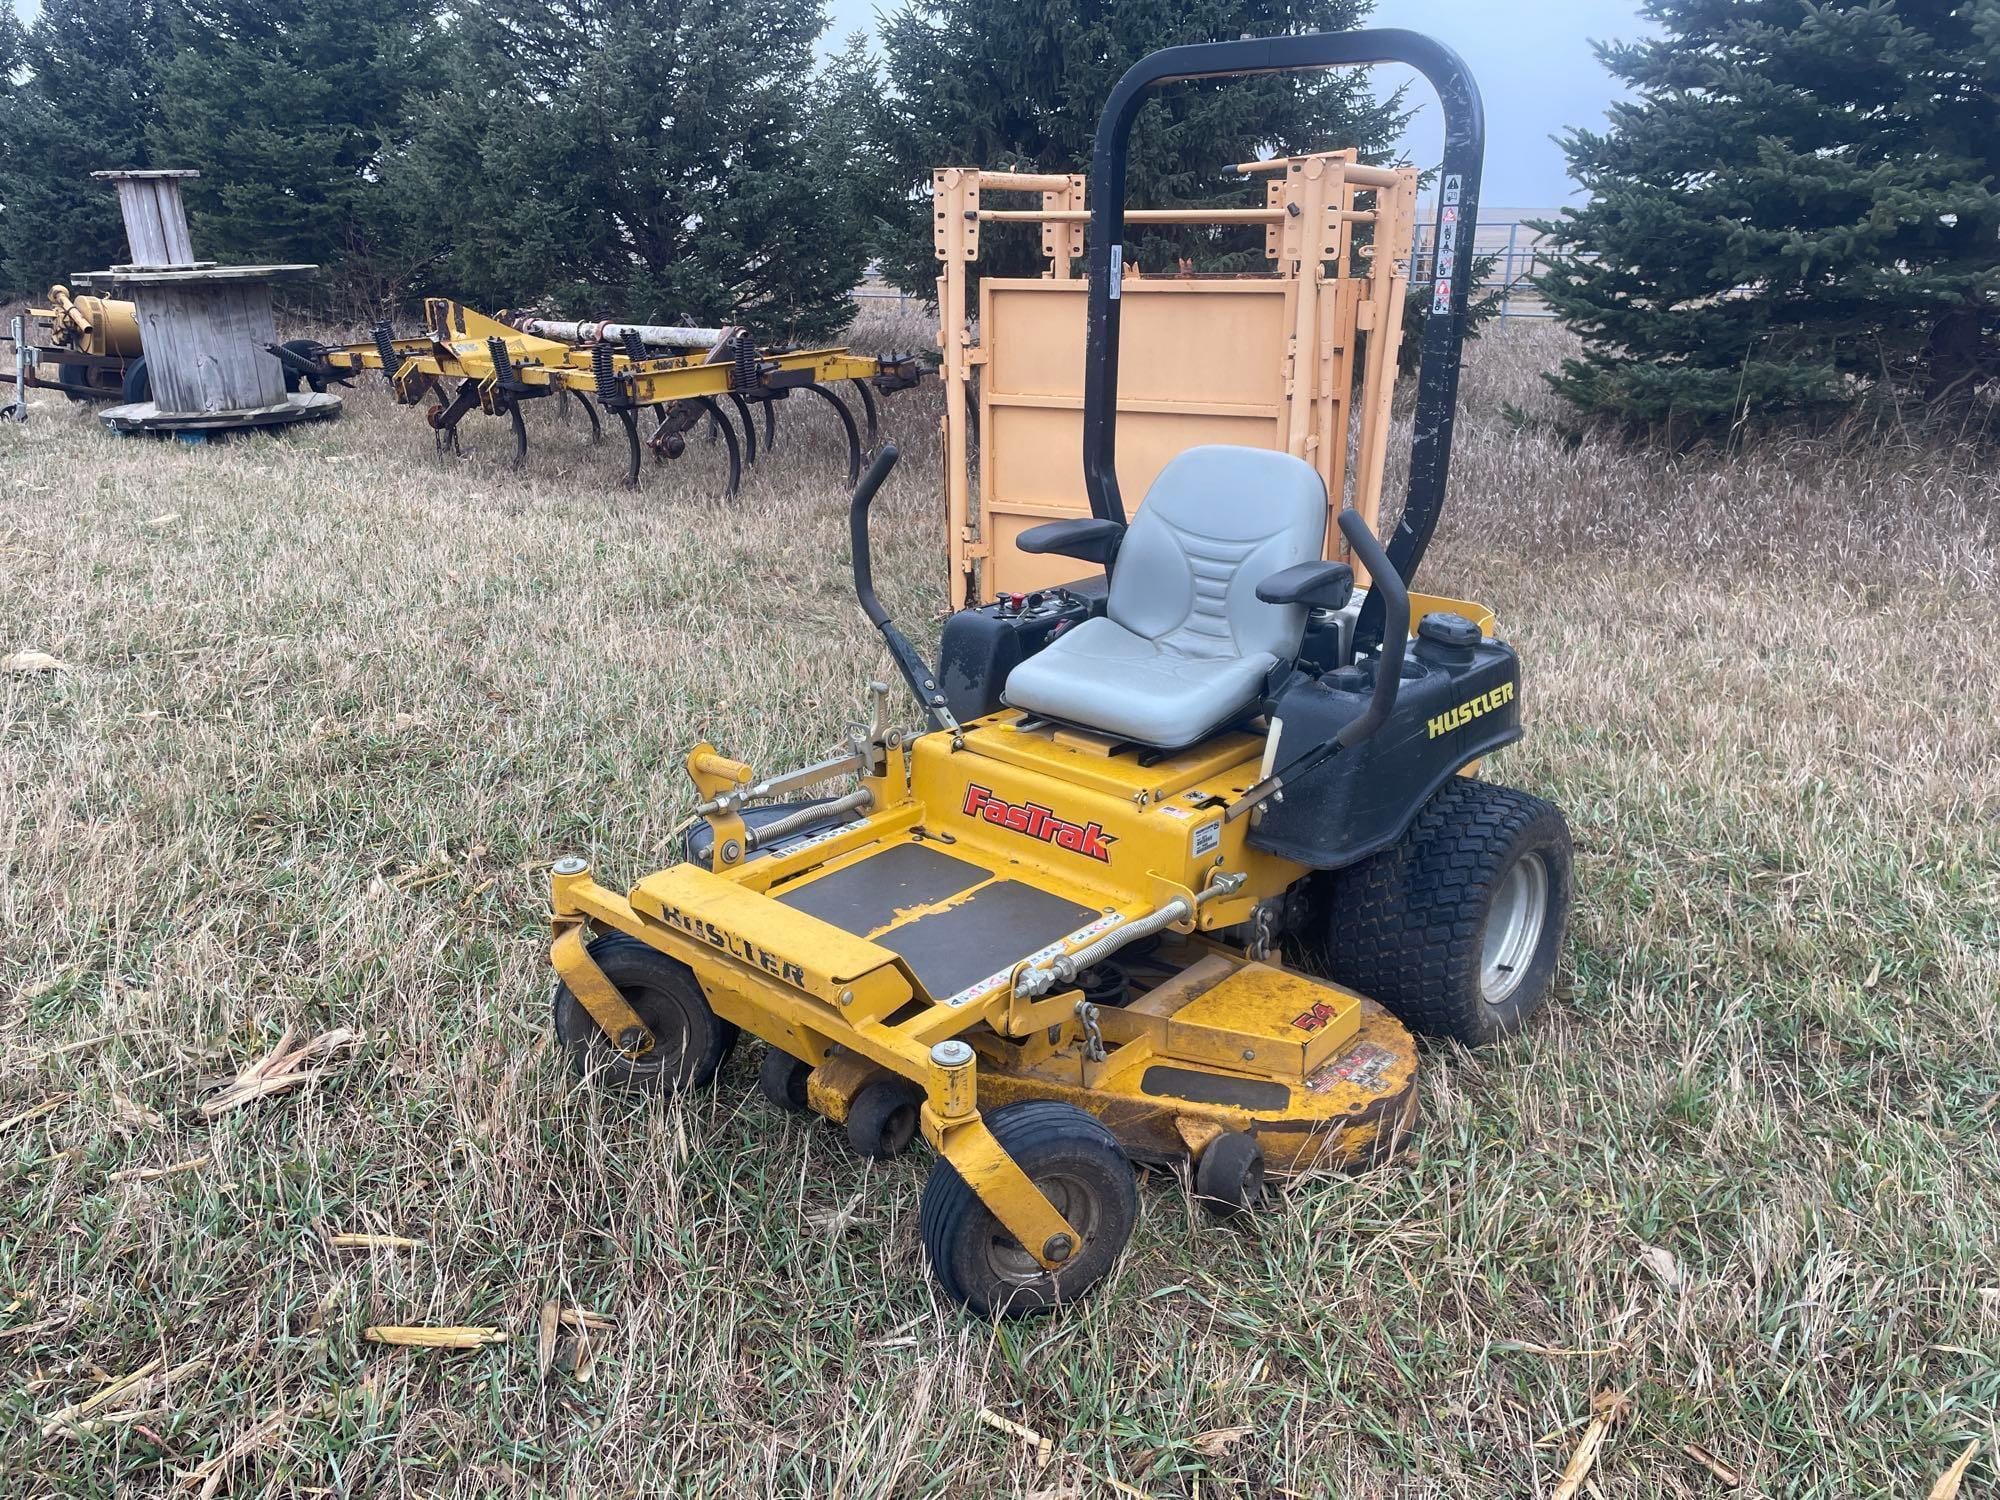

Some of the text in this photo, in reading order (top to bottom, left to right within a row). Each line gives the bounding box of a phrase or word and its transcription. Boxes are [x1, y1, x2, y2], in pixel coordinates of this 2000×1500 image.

[1427, 681, 1514, 740] HUSTLER
[963, 783, 1120, 865] FasTrak
[1290, 1001, 1337, 1032] 54
